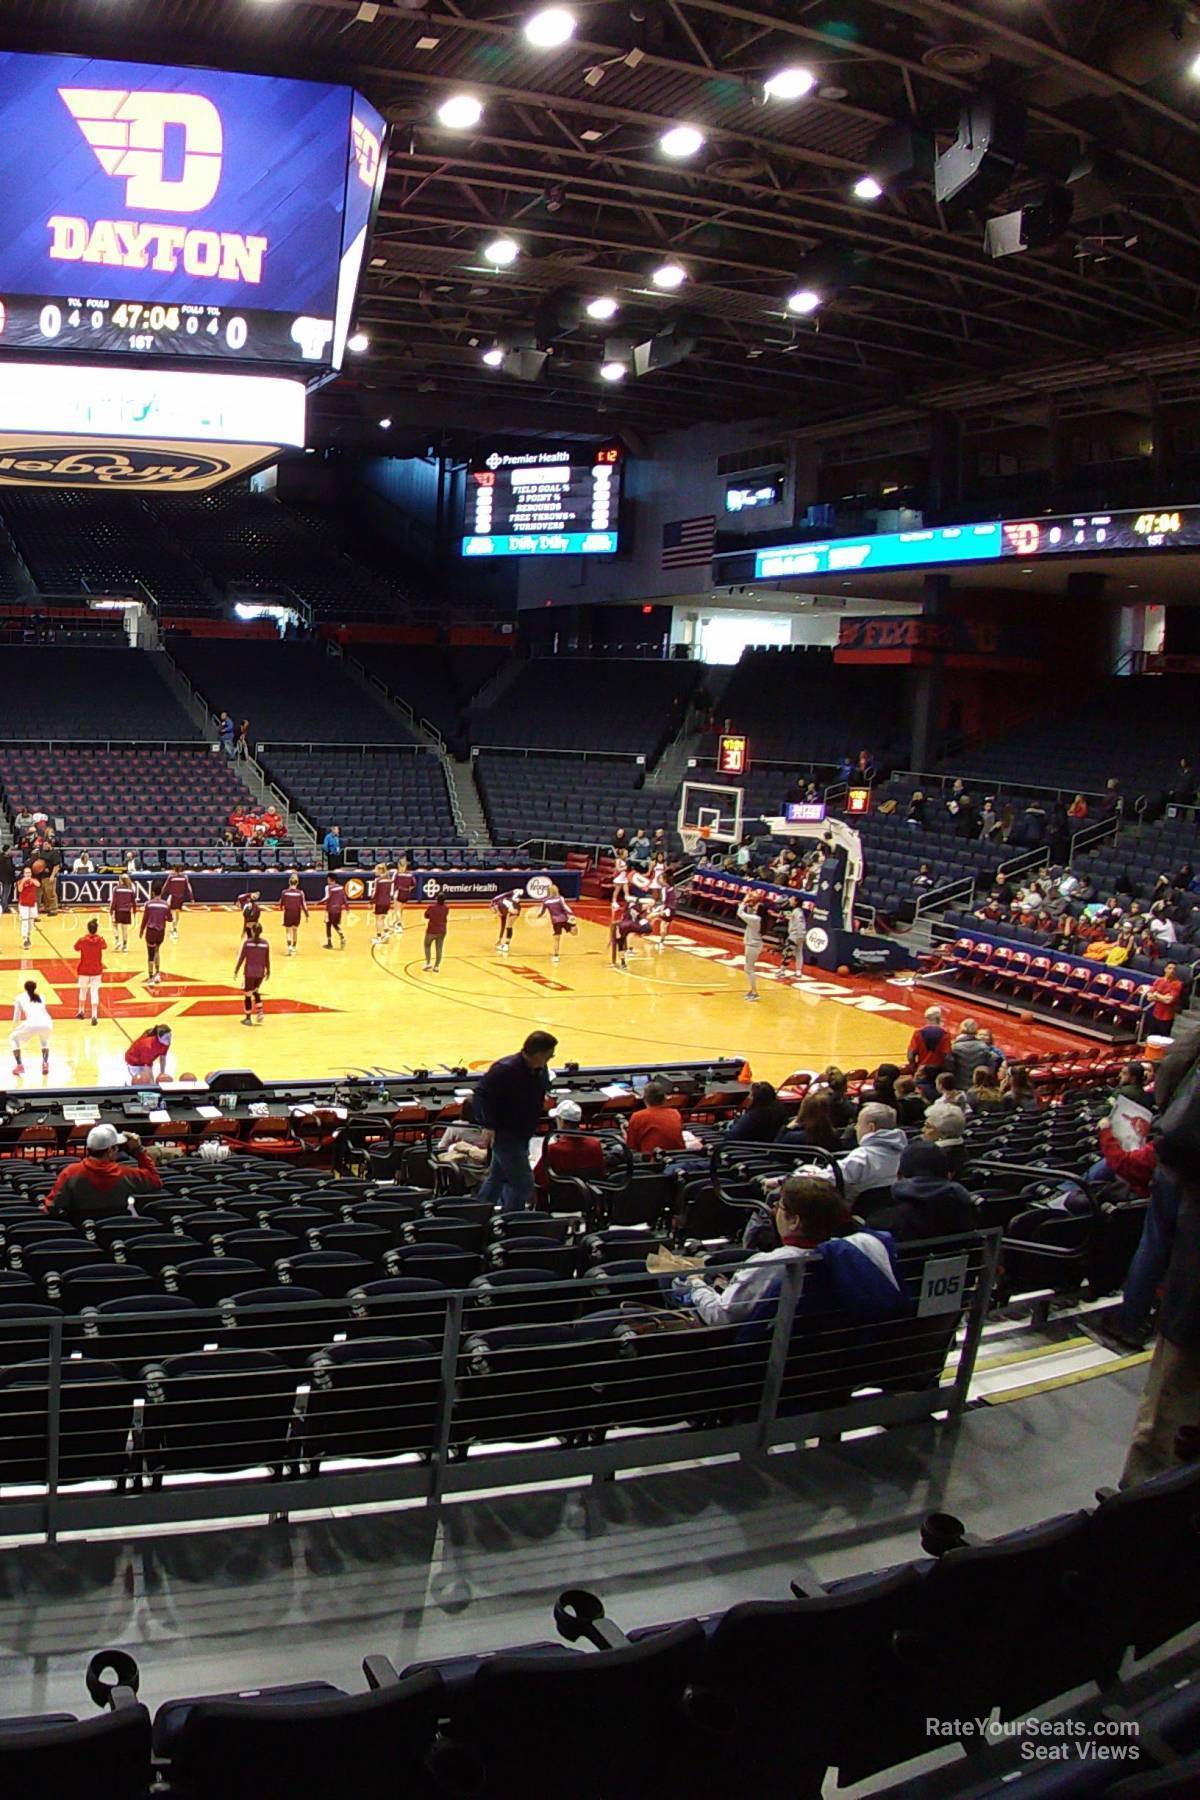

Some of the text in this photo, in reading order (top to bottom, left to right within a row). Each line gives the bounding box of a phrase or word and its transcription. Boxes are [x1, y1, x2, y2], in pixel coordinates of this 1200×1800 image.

[46, 215, 268, 284] DAYTON
[40, 304, 62, 338] 0
[68, 309, 104, 329] 4 0
[111, 303, 180, 332] 47:04
[186, 316, 219, 336] 0 4
[225, 316, 248, 350] 0
[128, 334, 155, 350] 1ST
[502, 451, 570, 465] Premier Health
[512, 485, 536, 494] FIELD
[537, 484, 561, 493] GOAL
[526, 494, 550, 502] POINT
[516, 503, 562, 512] REBOUNDS
[509, 513, 530, 522] FREE
[531, 512, 568, 521] THROWS
[1133, 513, 1181, 534] 47:04
[513, 521, 565, 531] TURNOVERS
[1074, 530, 1085, 544] 4
[442, 883, 498, 893] Premier Health
[927, 1276, 960, 1298] 105
